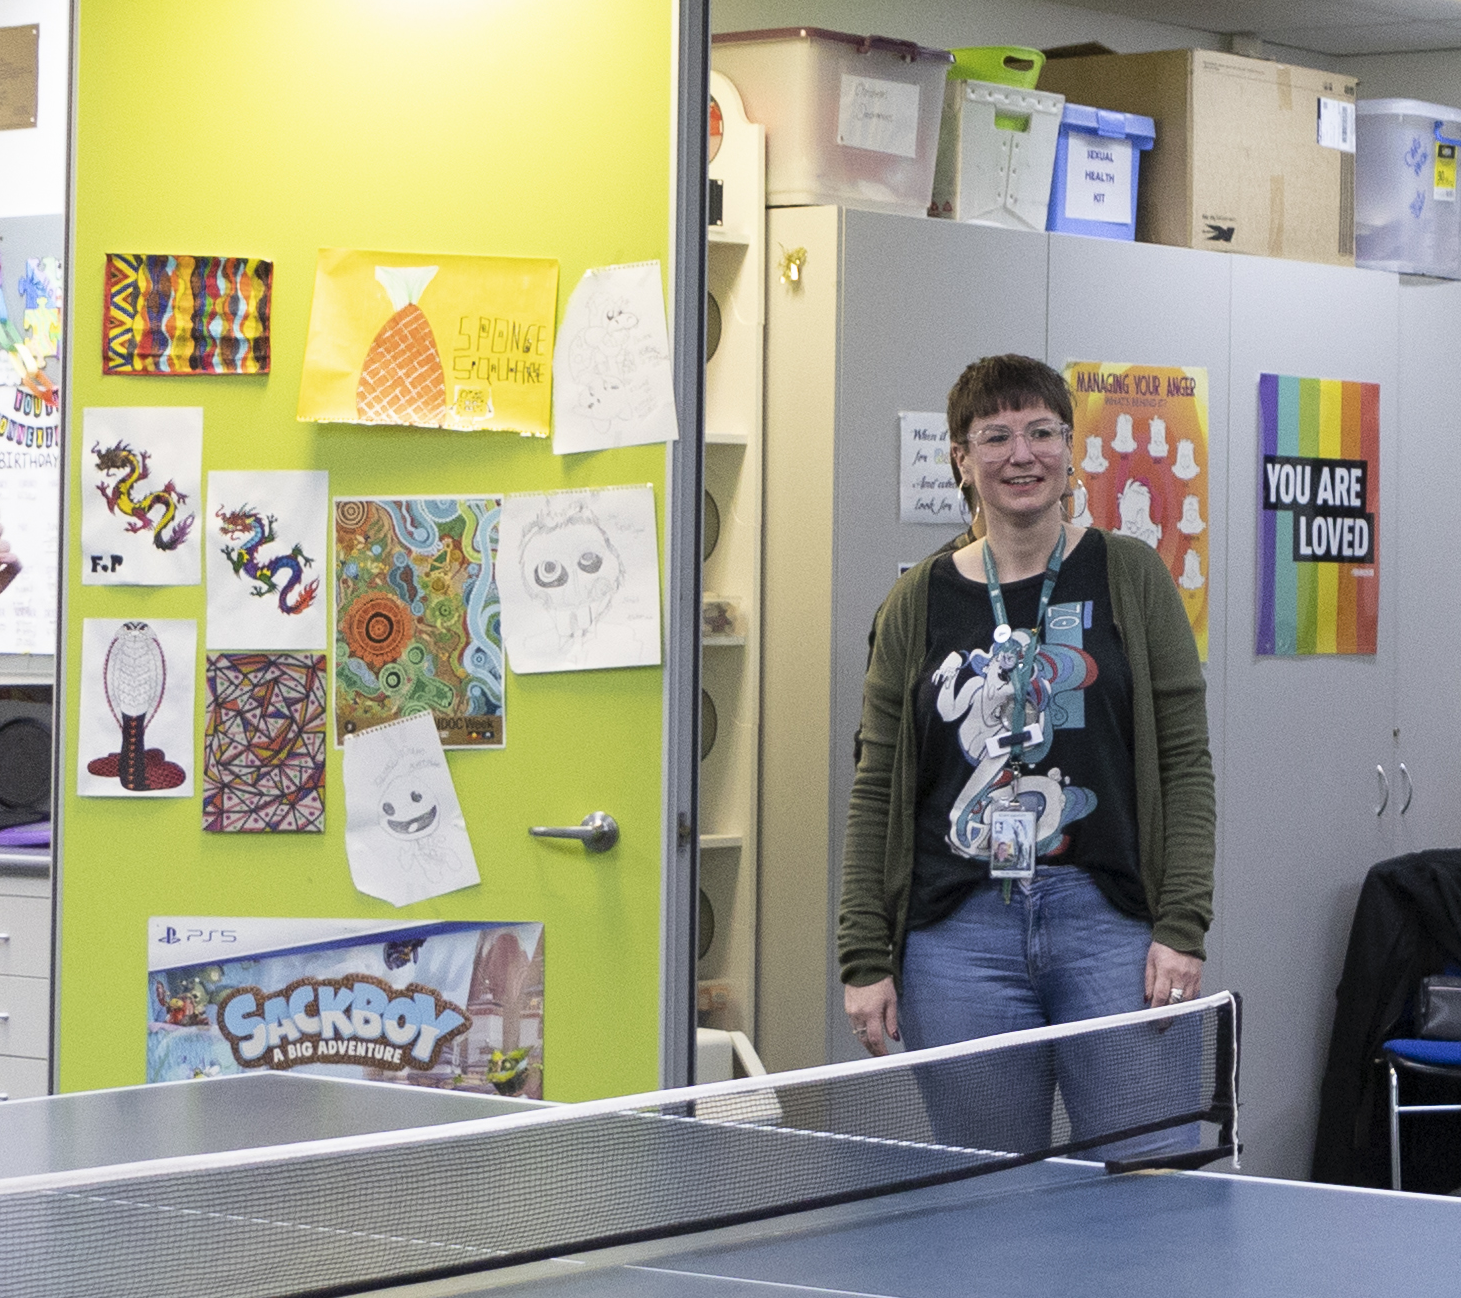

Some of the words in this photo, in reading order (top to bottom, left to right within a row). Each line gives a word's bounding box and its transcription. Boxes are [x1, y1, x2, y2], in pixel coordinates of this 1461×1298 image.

[1086, 150, 1114, 163] SEXUAL
[1084, 170, 1115, 184] HEALTH
[1093, 193, 1106, 204] KIT
[453, 316, 546, 355] SPONGE
[453, 355, 546, 384] SQUARE
[1076, 371, 1129, 394] MANAGING
[1133, 374, 1160, 396] YOUR
[1166, 375, 1196, 397] ANGER
[1266, 463, 1311, 505] YOU
[1316, 466, 1362, 507] ARE
[1299, 516, 1369, 557] LOVED
[466, 718, 494, 730] Week
[187, 928, 237, 943] PS5
[223, 980, 465, 1063] SACKBOY
[272, 1046, 285, 1064] A
[287, 1042, 313, 1061] BIG
[317, 1040, 403, 1064] ADVENTURE
